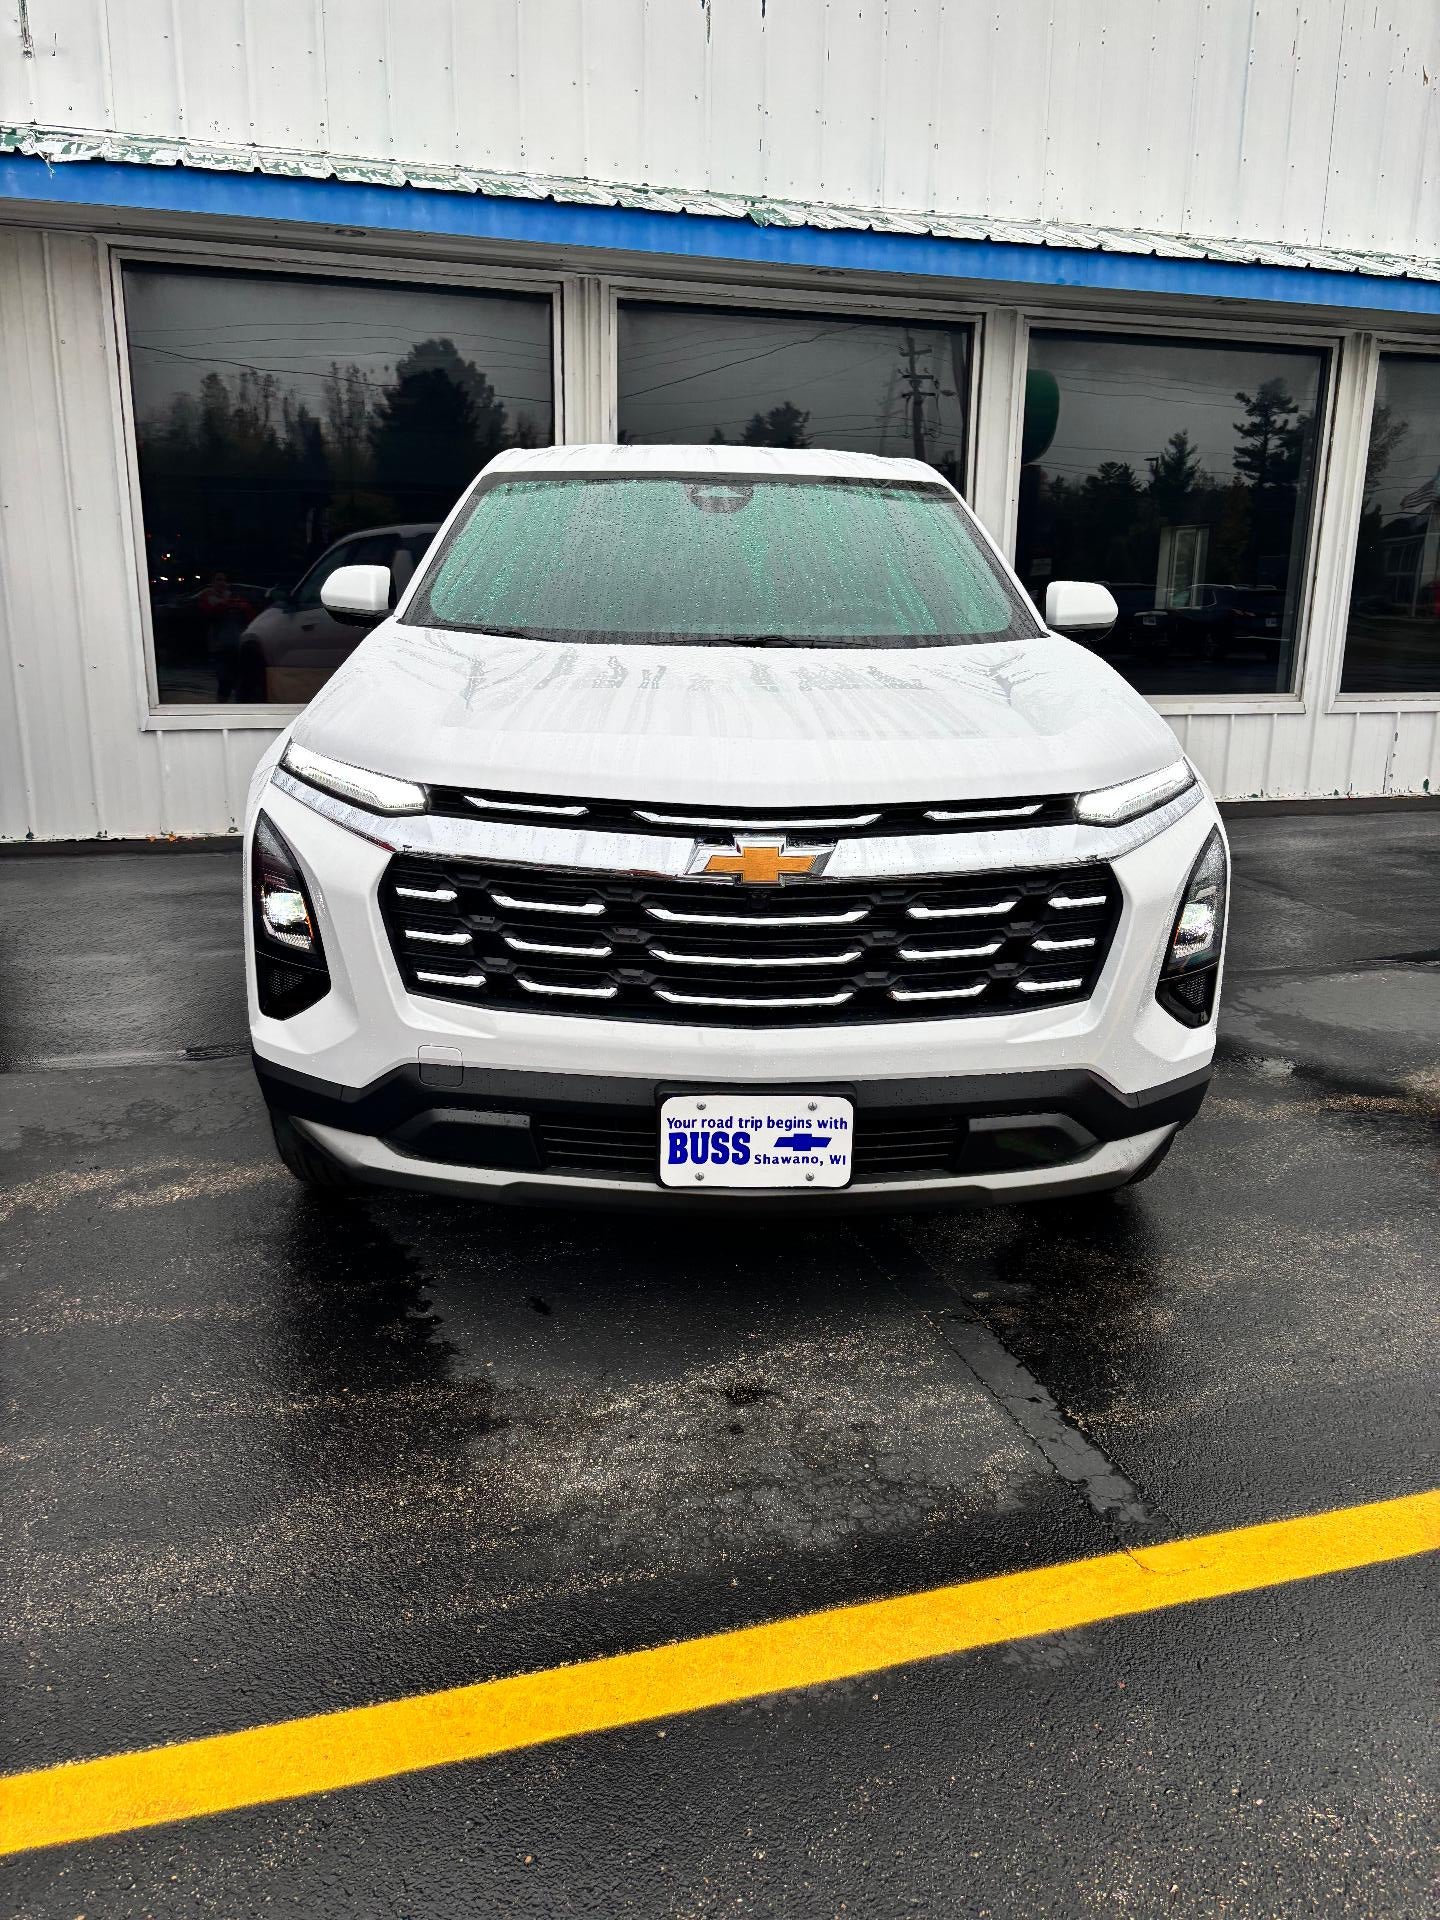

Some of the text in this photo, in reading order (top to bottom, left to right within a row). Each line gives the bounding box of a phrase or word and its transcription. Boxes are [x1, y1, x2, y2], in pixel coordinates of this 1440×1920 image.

[666, 1116, 848, 1132] Your road trip begins with
[668, 1131, 750, 1165] BUSS
[754, 1154, 846, 1167] Shawano, WI
